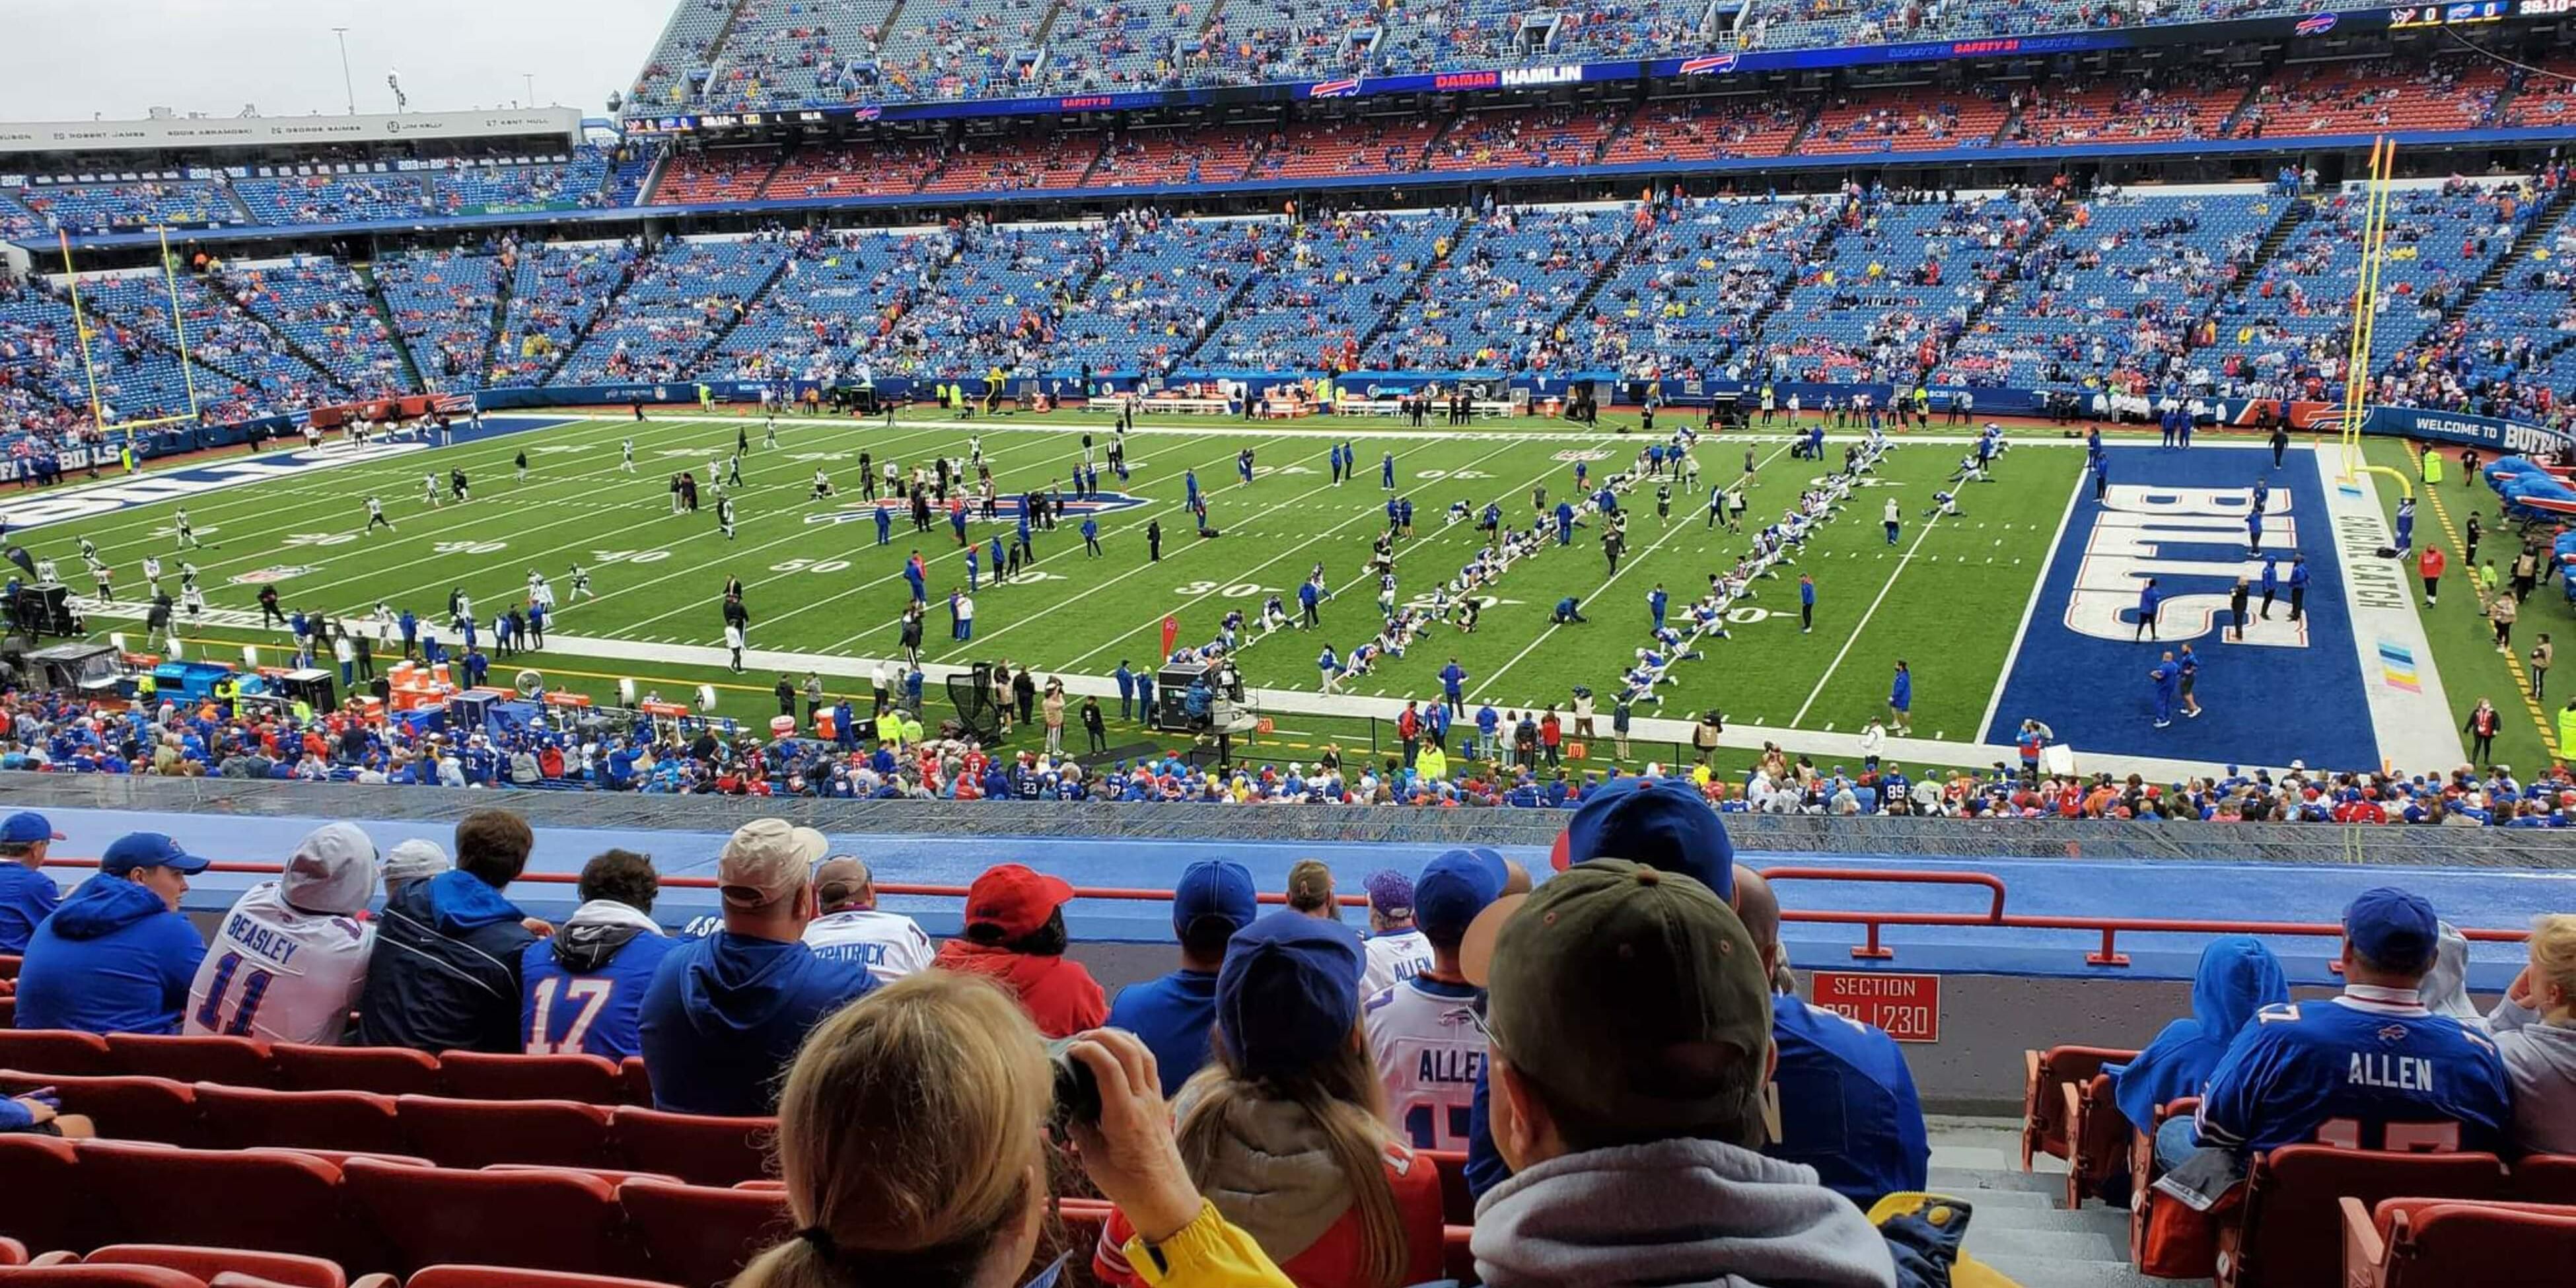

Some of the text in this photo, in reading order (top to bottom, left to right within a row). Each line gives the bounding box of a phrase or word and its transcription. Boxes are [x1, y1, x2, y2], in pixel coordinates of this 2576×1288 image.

[2425, 8, 2436, 20] 0
[2484, 3, 2495, 16] 0
[1953, 42, 2001, 54] SAFETY
[1435, 66, 1582, 89] DAMAR HAMLIN
[2416, 417, 2479, 436] WELCOME
[2484, 426, 2498, 439] TO
[769, 558, 851, 573] 50
[2064, 484, 2310, 647] BILLS
[1174, 581, 1261, 598] 30
[2350, 564, 2406, 610] CATCH
[1023, 783, 1038, 795] 23
[1110, 784, 1121, 797] 17
[1886, 785, 1906, 800] 89
[227, 914, 298, 964] BEASLEY
[1394, 955, 1433, 982] ALLEN
[196, 951, 273, 1038] 11
[1833, 977, 1915, 997] SECTION
[526, 976, 614, 1054] 17
[1882, 1005, 1928, 1034] 230
[1418, 1049, 1482, 1083] ALLE
[2347, 1052, 2433, 1092] ALLEN
